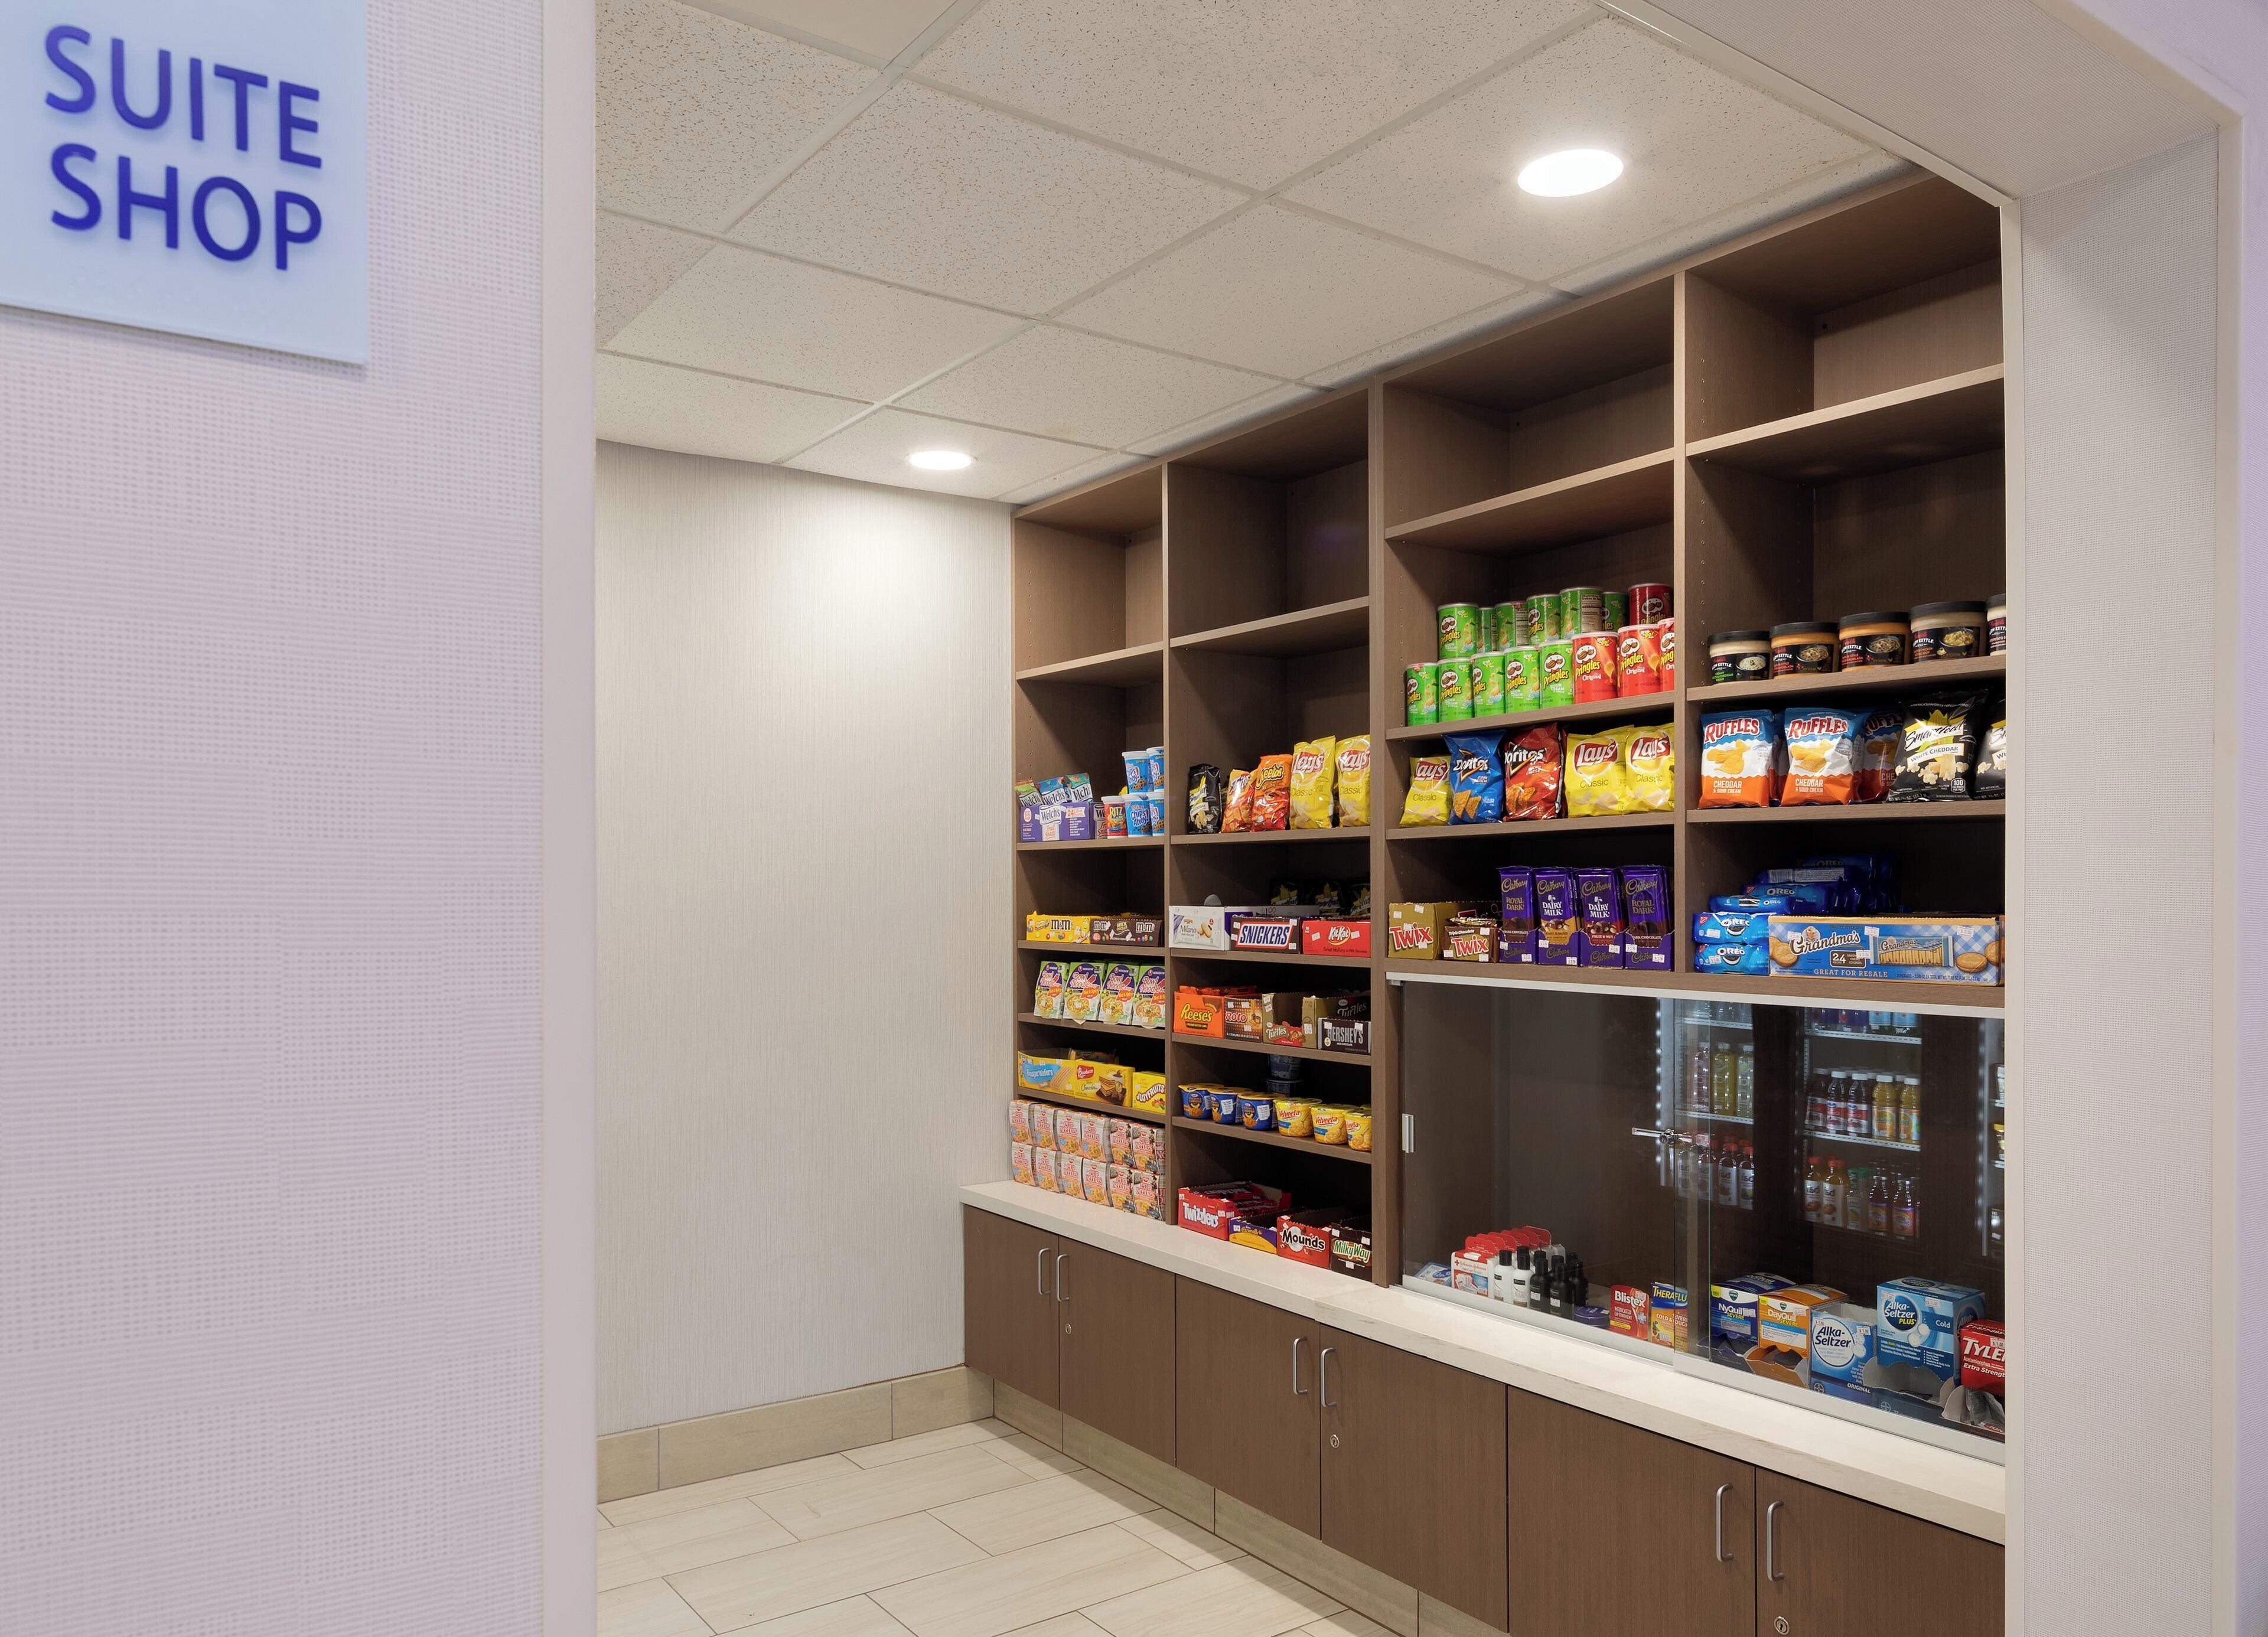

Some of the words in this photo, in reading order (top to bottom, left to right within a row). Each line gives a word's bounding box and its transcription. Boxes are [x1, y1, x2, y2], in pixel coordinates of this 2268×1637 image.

[45, 25, 322, 169] SUITE
[51, 142, 322, 271] SHOP
[1575, 660, 1601, 681] Pringles
[1620, 653, 1644, 675] Pringles
[1506, 676, 1527, 696] Pringles
[1543, 670, 1569, 690] Pringles
[1440, 686, 1461, 704] Pringles
[1705, 718, 1759, 743] RUFFLES
[1789, 718, 1848, 739] RUFFLES
[1576, 744, 1616, 767] Lay's
[1632, 737, 1669, 761] Lay's
[1293, 752, 1324, 774] Lay's
[1911, 752, 1928, 762] WHITE
[1453, 758, 1488, 771] Doritos
[1413, 762, 1448, 781] Lay's
[1635, 774, 1663, 782] Classic
[1795, 778, 1823, 787] CHEDDAR
[1413, 793, 1437, 801] Classic
[1041, 807, 1060, 821] Welch's
[1109, 807, 1123, 817] RITZ
[1131, 810, 1146, 819] Chips
[1133, 811, 1149, 826] Ahoy!
[1501, 878, 1528, 893] Cadbury
[1537, 879, 1565, 895] Cadbury
[1582, 881, 1612, 896] Cadbury
[1625, 879, 1657, 895] Cadbury
[1179, 925, 1197, 934] Milano
[1240, 925, 1291, 945] SNICKERS
[1790, 930, 1860, 955] Grandma's
[1881, 938, 1917, 951] Grandma's
[1546, 946, 1570, 959] Cadbury
[1716, 947, 1746, 956] OREO
[1832, 953, 1846, 964] 24
[1142, 976, 1159, 984] Bowl
[1181, 1003, 1213, 1022] Reese's
[1337, 1003, 1367, 1017] Turtles
[1266, 1028, 1287, 1039] Turtles
[1328, 1025, 1364, 1044] HERSHEY'S
[1026, 1069, 1040, 1078] Sugar
[1040, 1069, 1054, 1077] Wafers
[1136, 1084, 1165, 1103] JUJYFRUITS
[1315, 1116, 1338, 1124] Velveeta
[1140, 1182, 1151, 1191] CUP
[1182, 1202, 1219, 1228] Twizzlers
[1282, 1229, 1325, 1251] Mounds
[1615, 1290, 1645, 1309] Blistex
[1653, 1285, 1687, 1302] THERAFLU
[1719, 1303, 1742, 1315] NyQuil
[1886, 1301, 1910, 1310] Alka-
[1727, 1312, 1745, 1320] SEVERE
[1768, 1309, 1797, 1322] DayQuil
[1884, 1309, 1915, 1319] Seltzer
[1780, 1319, 1799, 1327] SEVERE
[1936, 1319, 1950, 1329] Cold
[1817, 1326, 1845, 1337] Alka-
[1814, 1336, 1851, 1348] Seltzer
[1963, 1356, 1991, 1367] Acetaminophen
[1963, 1363, 1980, 1372] Extra
[1847, 1382, 1871, 1394] ORIGINAL
